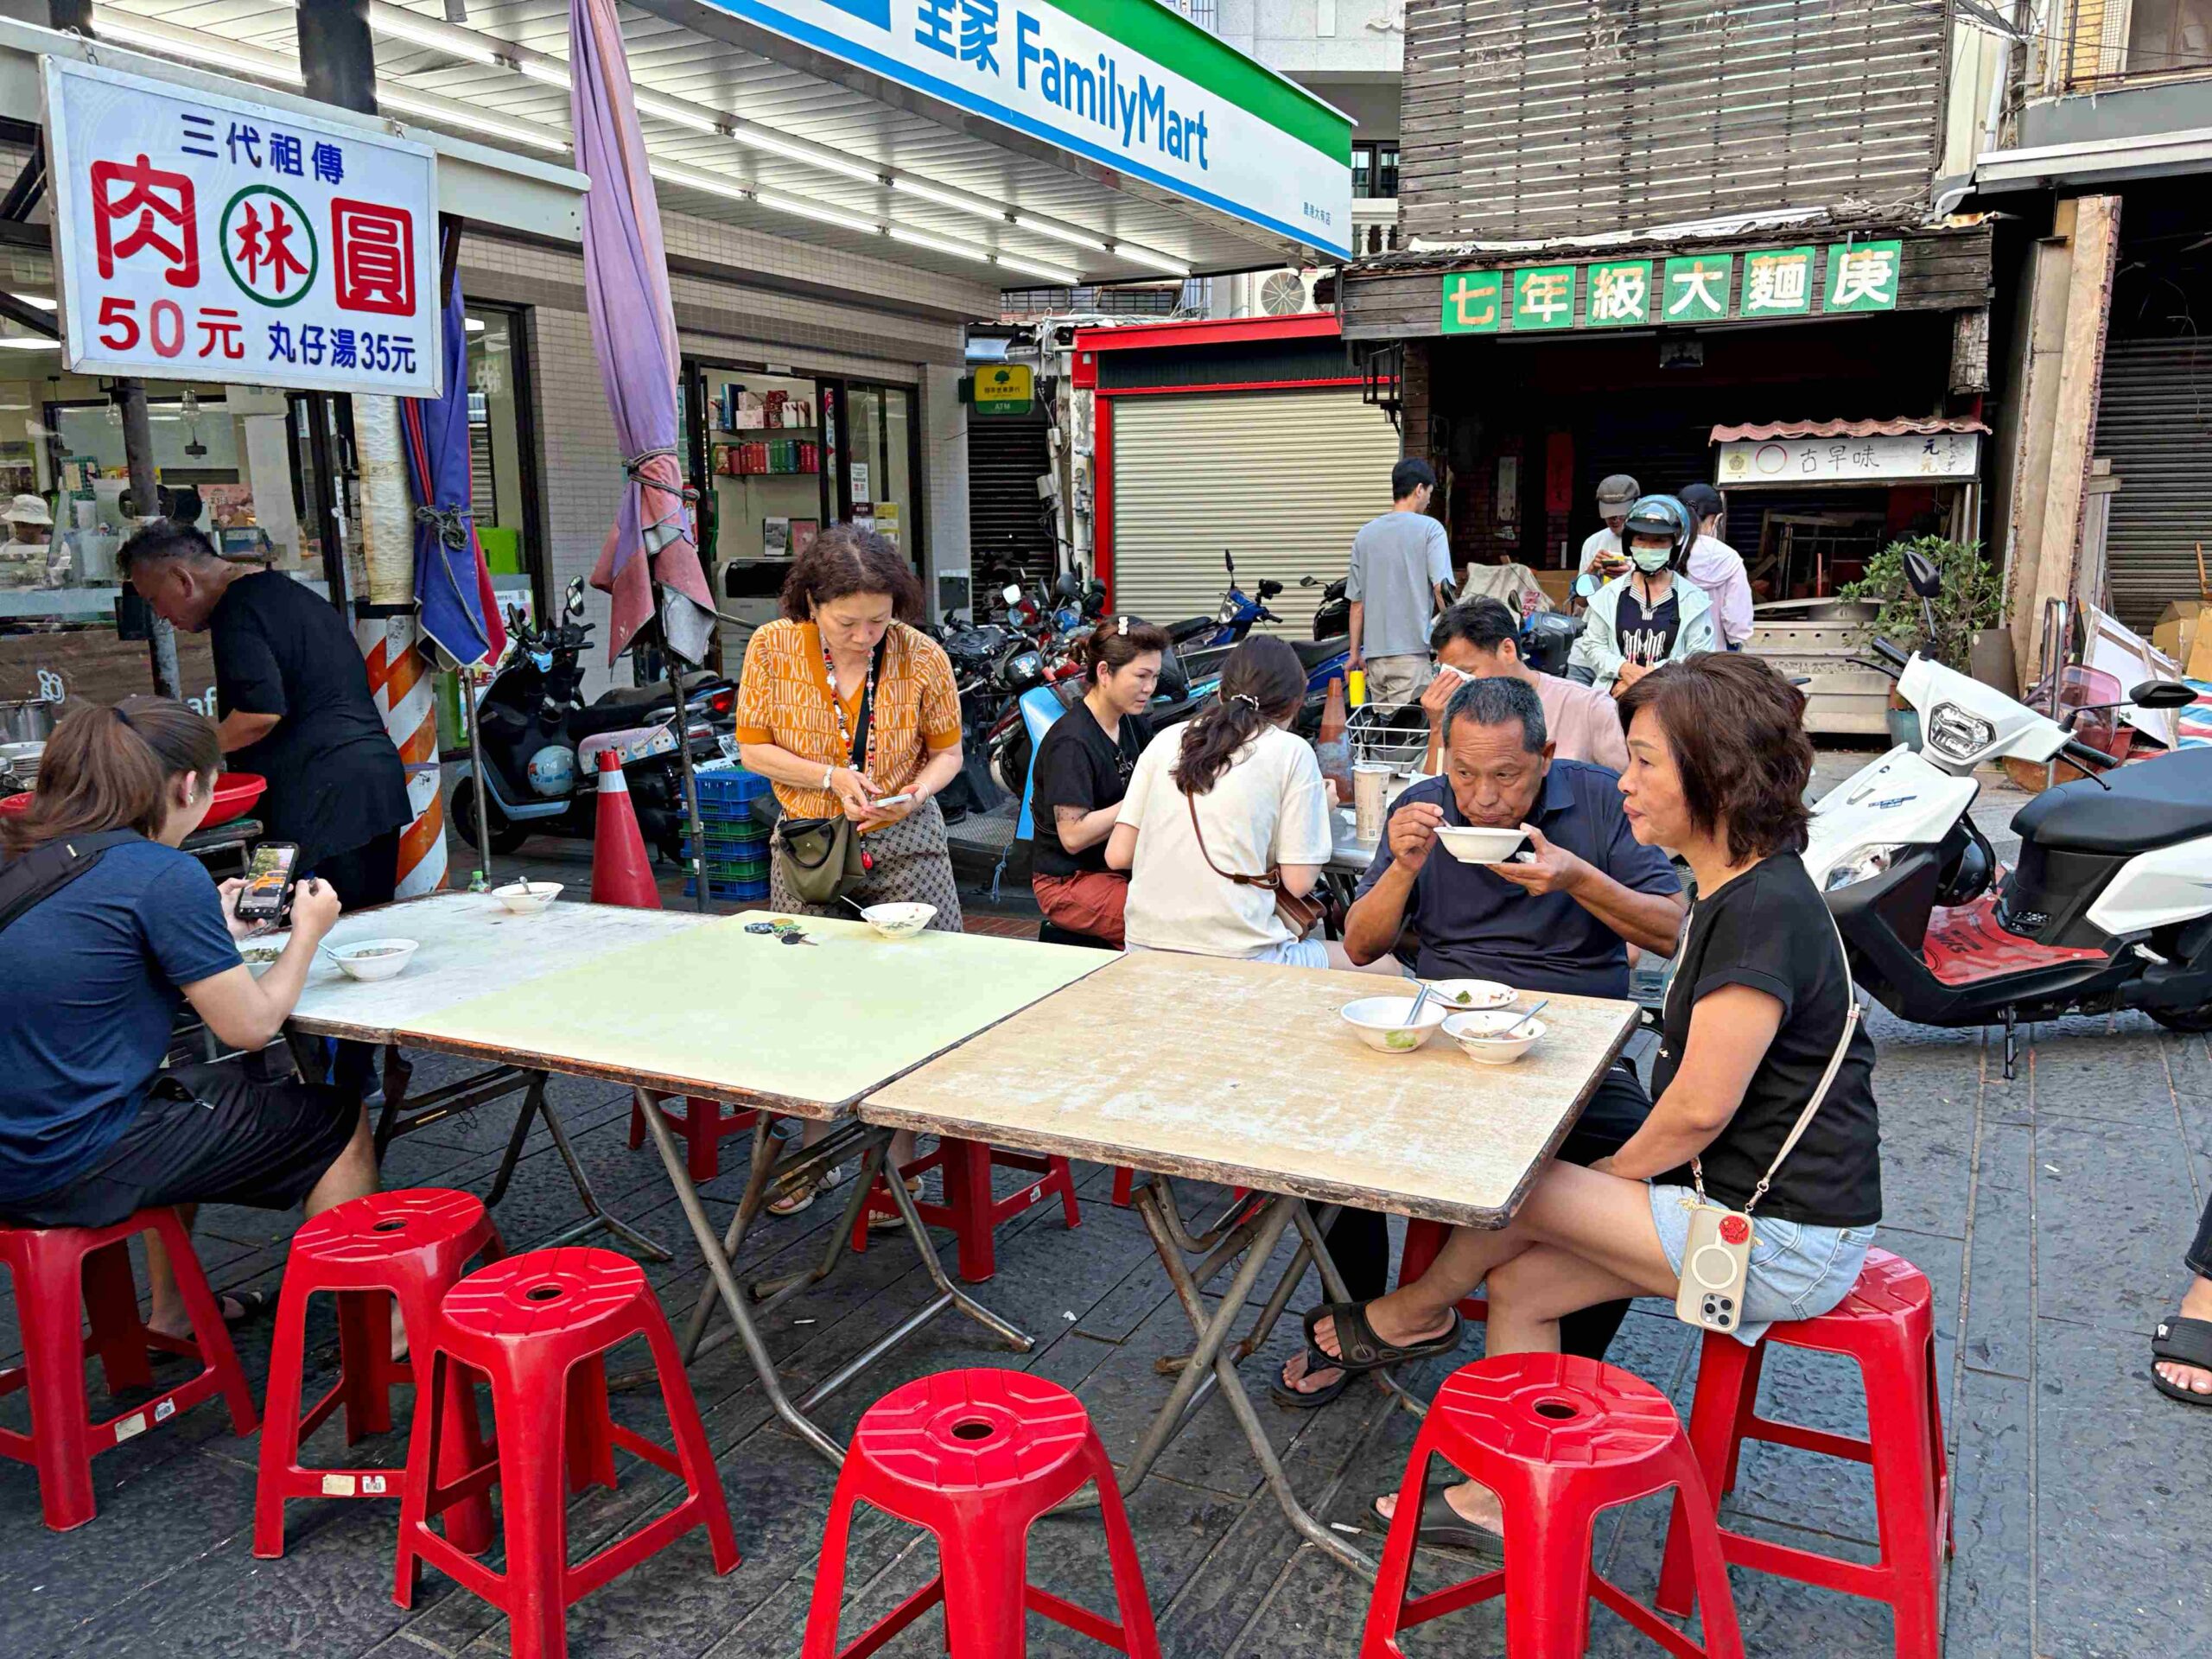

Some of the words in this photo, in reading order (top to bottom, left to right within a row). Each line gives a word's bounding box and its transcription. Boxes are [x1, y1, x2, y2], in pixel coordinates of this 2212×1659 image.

[1017, 10, 1209, 171] FamilyMart
[181, 113, 345, 185] 三代祖傳
[90, 154, 200, 289] 肉
[235, 201, 308, 295] 林
[330, 197, 416, 317] 圓
[99, 297, 245, 360] 50元
[267, 321, 416, 375] 丸仔湯35元
[1800, 444, 1880, 473] 古早味
